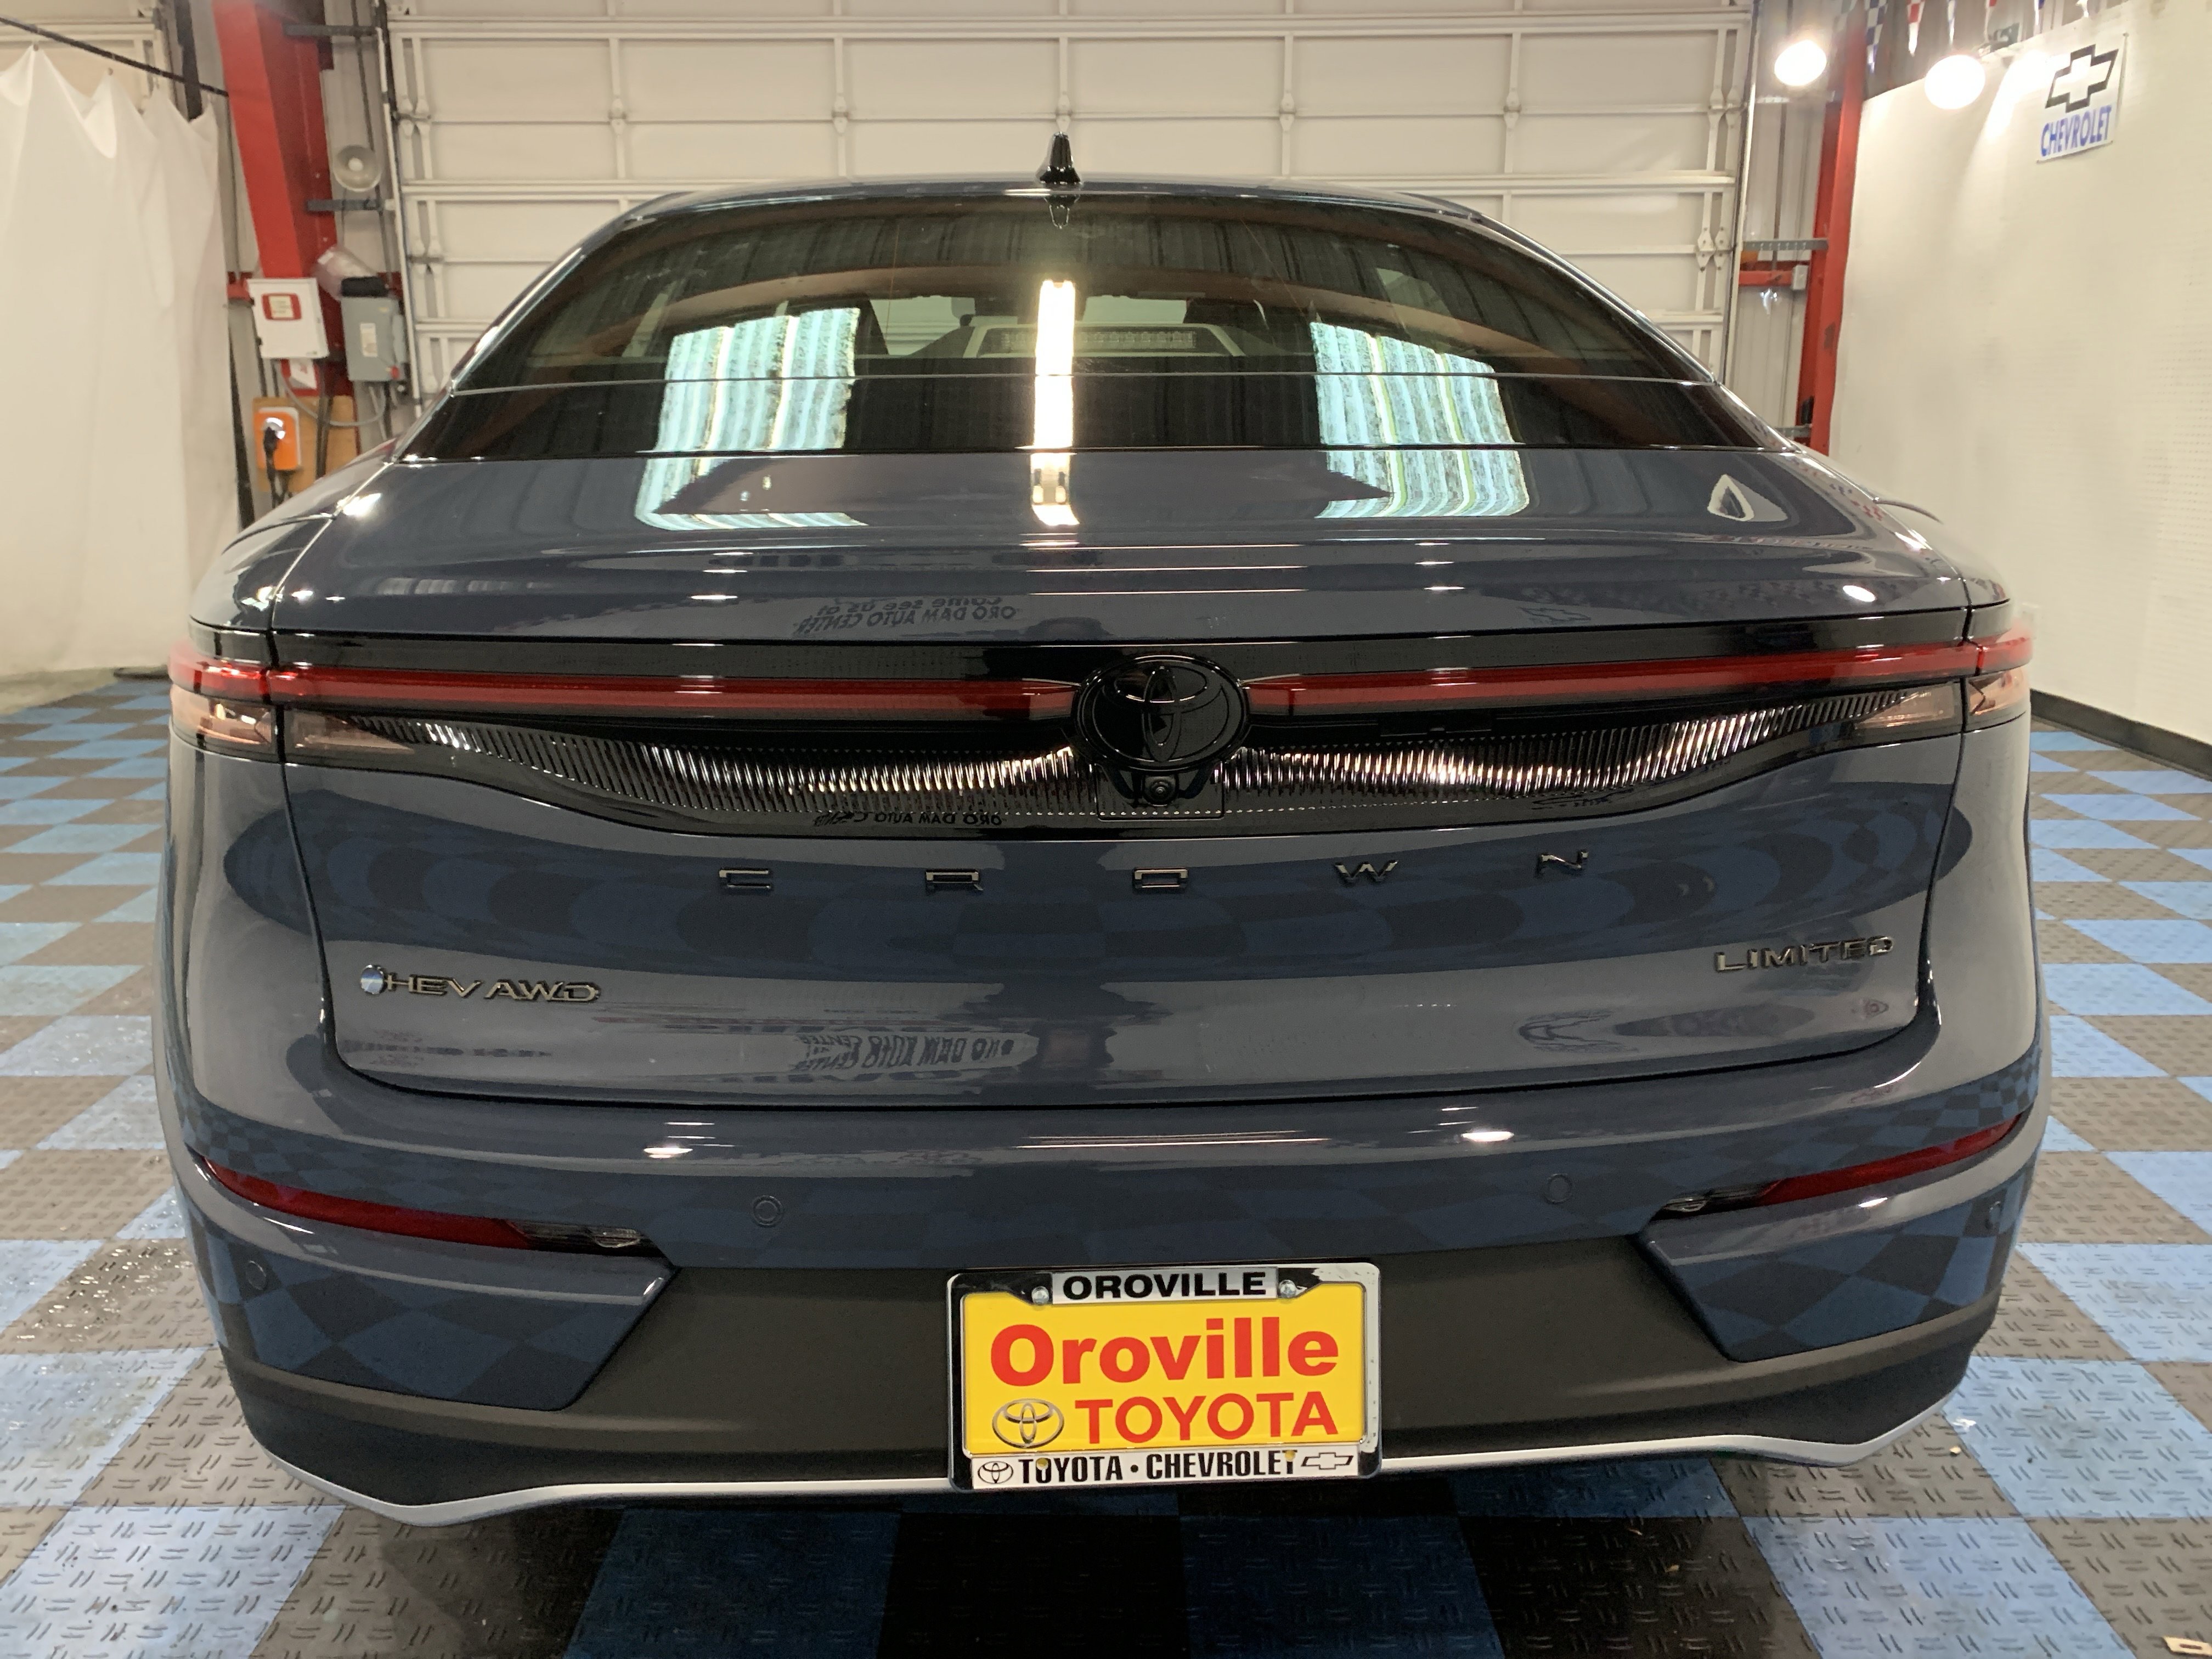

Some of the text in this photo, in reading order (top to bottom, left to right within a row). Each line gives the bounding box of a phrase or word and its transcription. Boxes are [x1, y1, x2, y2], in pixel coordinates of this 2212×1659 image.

[2040, 105, 2112, 157] CHEVROLET
[719, 849, 1589, 891] CROWN
[1714, 935, 1896, 973] LIMITED
[385, 973, 601, 1002] HEV AWD
[1063, 1272, 1267, 1300] OROVILLE
[990, 1317, 1339, 1387] Oroville
[1075, 1391, 1339, 1444] TOYOTA
[1018, 1449, 1297, 1484] TOYOTA CHEVROLET
